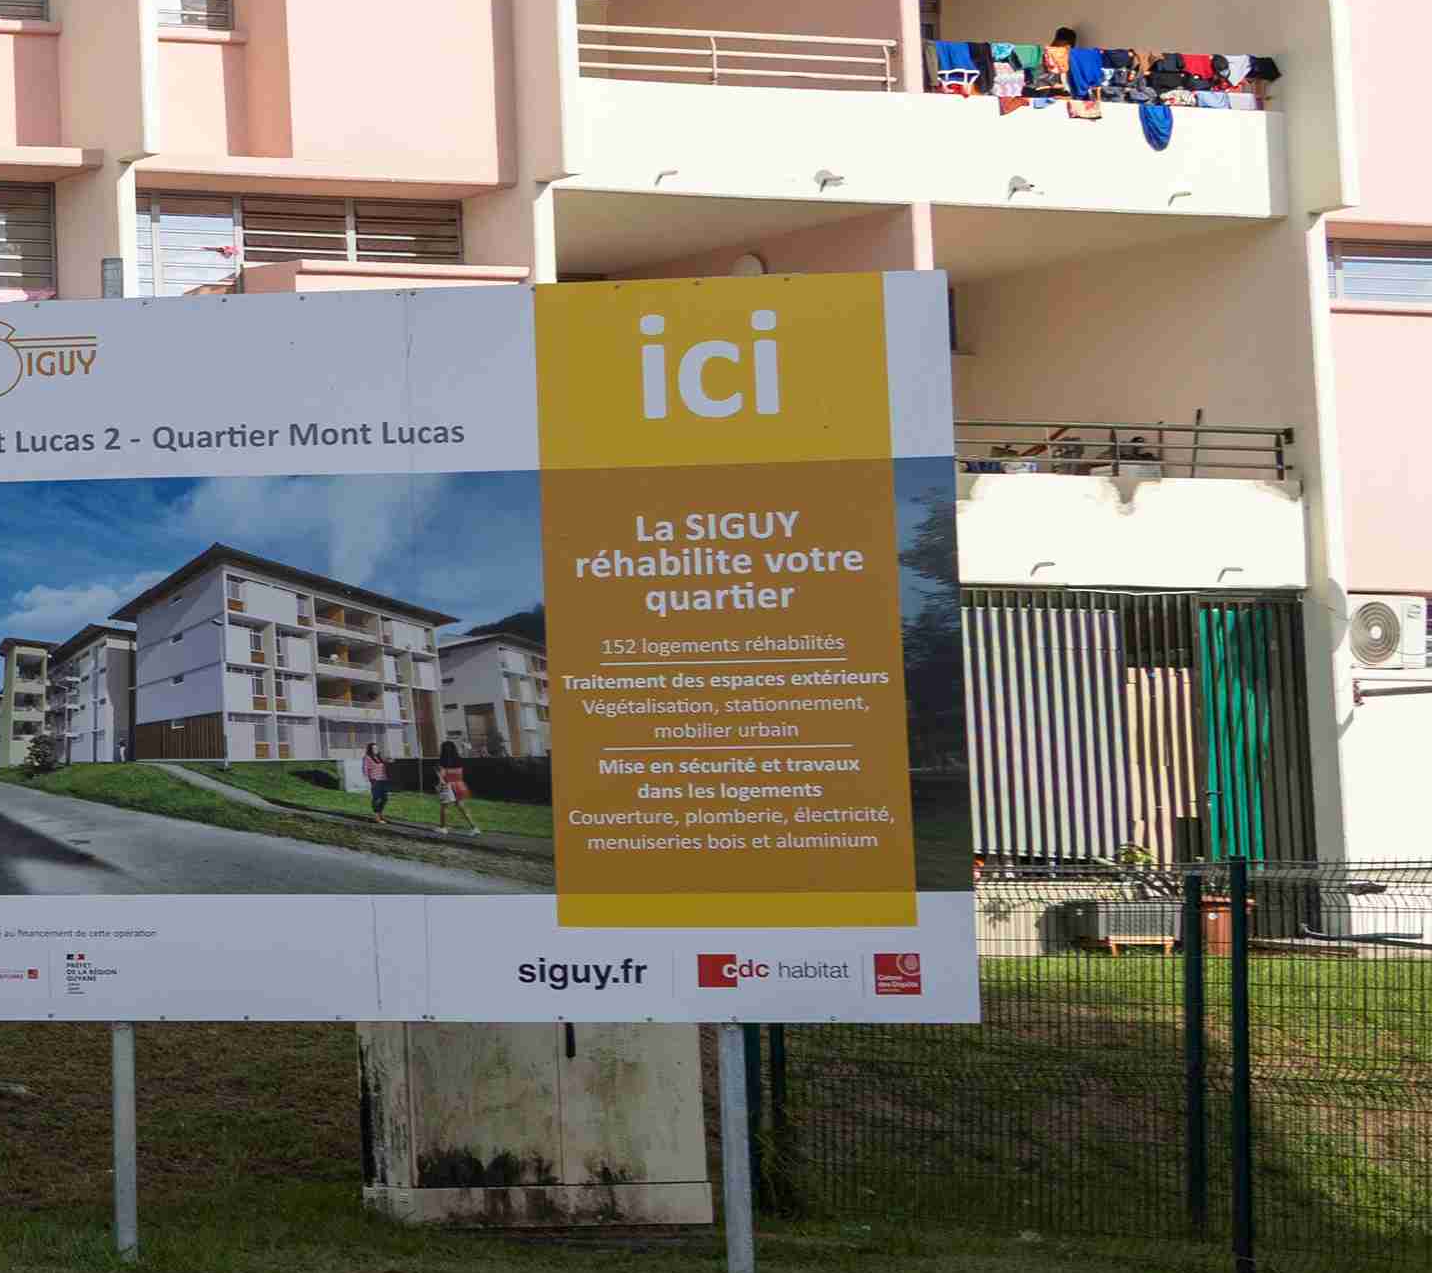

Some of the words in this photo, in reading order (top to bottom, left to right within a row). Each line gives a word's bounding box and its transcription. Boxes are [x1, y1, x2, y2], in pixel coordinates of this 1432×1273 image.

[640, 310, 780, 419] ici
[16, 431, 94, 452] Lucas
[104, 428, 120, 450] 2
[153, 424, 279, 452] Quartier
[290, 423, 372, 446] Mont
[383, 422, 464, 444] Lucas
[637, 516, 674, 541] La
[686, 511, 799, 540] SIGUY
[576, 548, 752, 577] réhabilite
[764, 548, 864, 573] votre
[646, 582, 794, 617] quartier
[602, 639, 636, 654] 152
[643, 638, 740, 656] logements
[745, 635, 845, 651] réhabilités
[562, 675, 666, 689] Traitement
[672, 673, 704, 688] des
[710, 675, 785, 690] espaces
[791, 670, 888, 685] extérieurs
[582, 698, 719, 717] Végétalisation,
[726, 697, 869, 712] stationnement,
[655, 723, 732, 738] mobilier
[739, 722, 798, 737] urbain
[600, 759, 645, 774] Mise
[650, 762, 673, 773] en
[679, 758, 757, 773] sécurité
[761, 759, 782, 772] et
[786, 758, 860, 774] travaux
[638, 784, 683, 798] dans
[688, 783, 715, 798] les
[720, 783, 824, 801] logements
[569, 810, 679, 826] Couverture,
[686, 809, 788, 826] plomberie,
[794, 806, 894, 823] électricité,
[588, 834, 702, 850] menuiseries
[708, 834, 746, 849] bois
[752, 836, 771, 848] et
[776, 833, 878, 848] aluminium
[519, 958, 647, 990] siguy.fr
[722, 959, 770, 979] cdc
[777, 959, 850, 980] habitat
